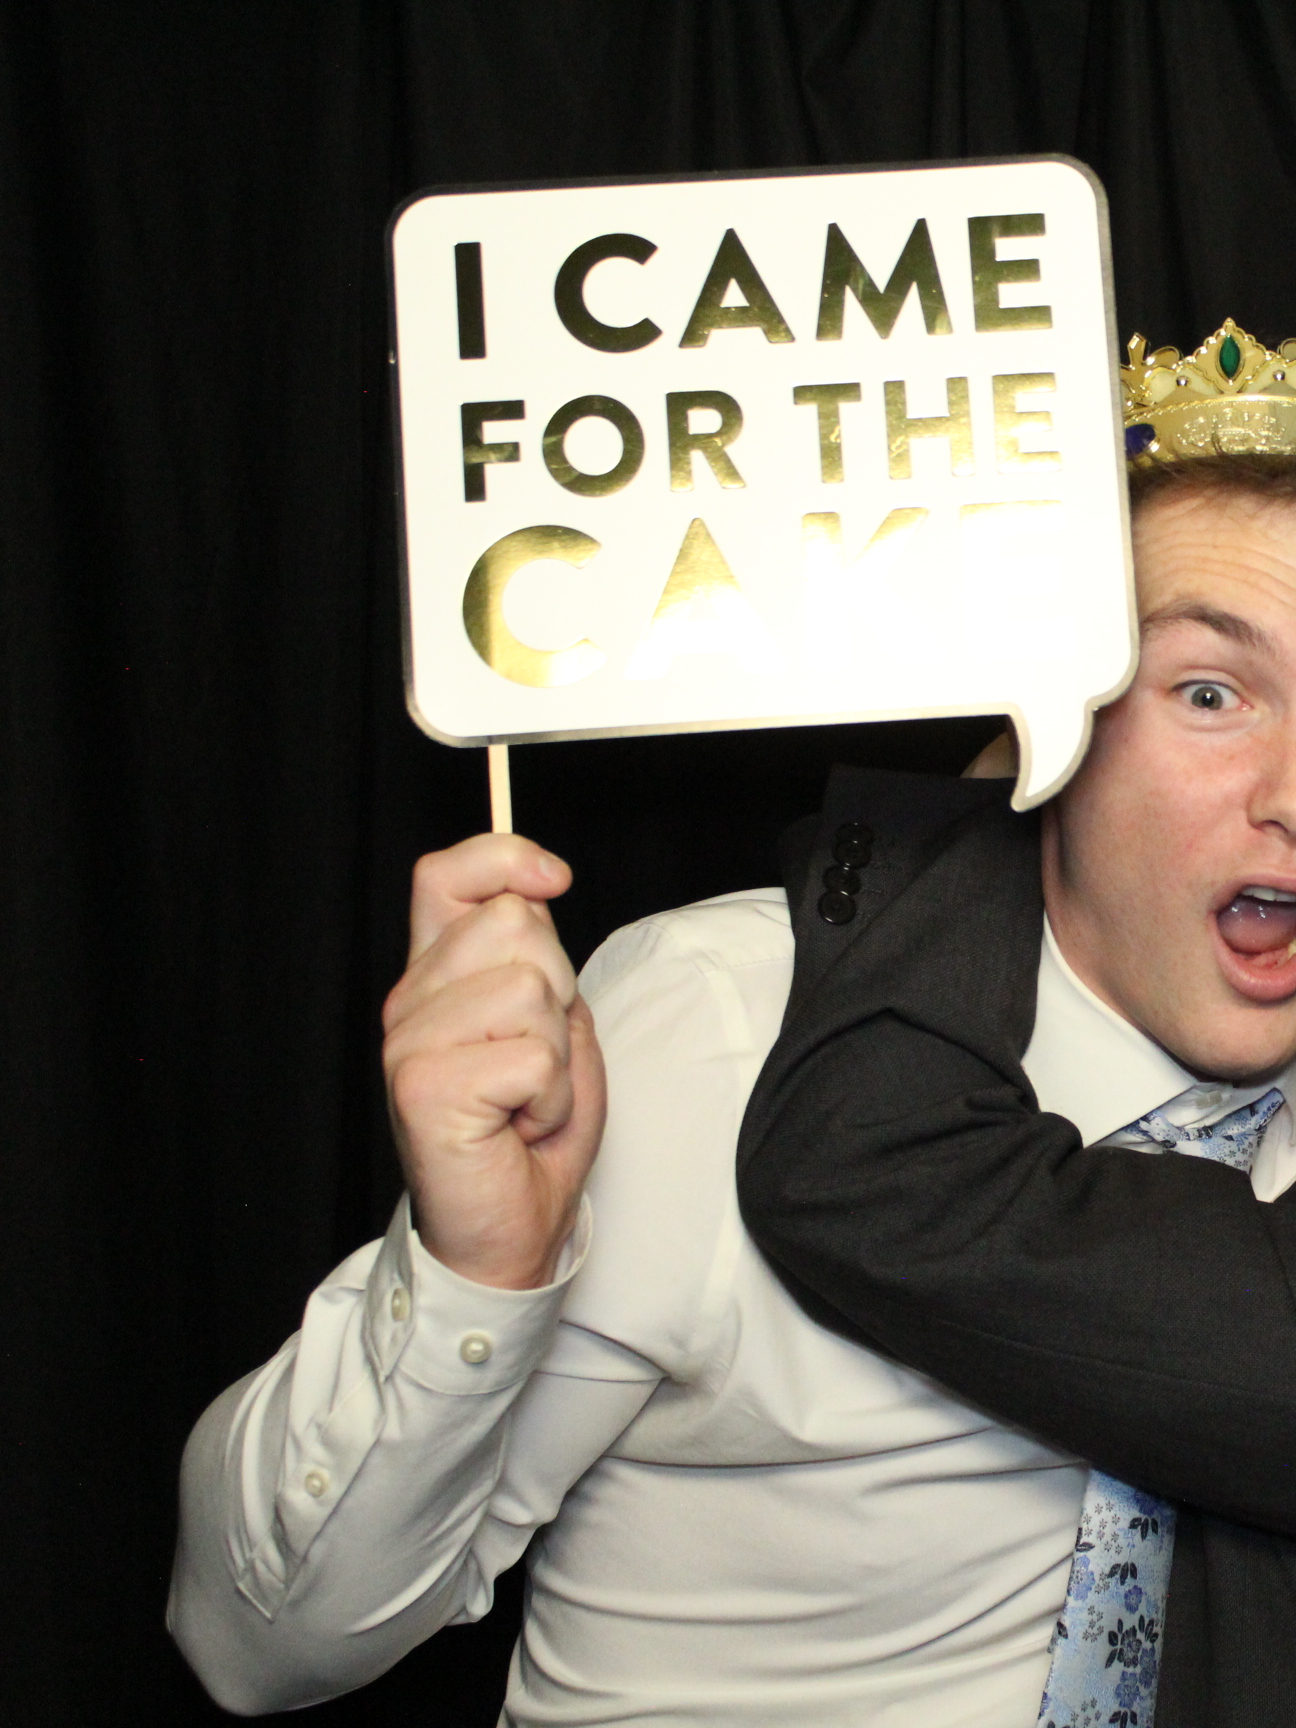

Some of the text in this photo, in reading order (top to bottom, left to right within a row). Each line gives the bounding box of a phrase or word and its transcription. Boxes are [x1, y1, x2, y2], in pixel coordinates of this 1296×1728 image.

[454, 213, 1053, 359] I CAME
[460, 372, 1063, 502] FOR THE
